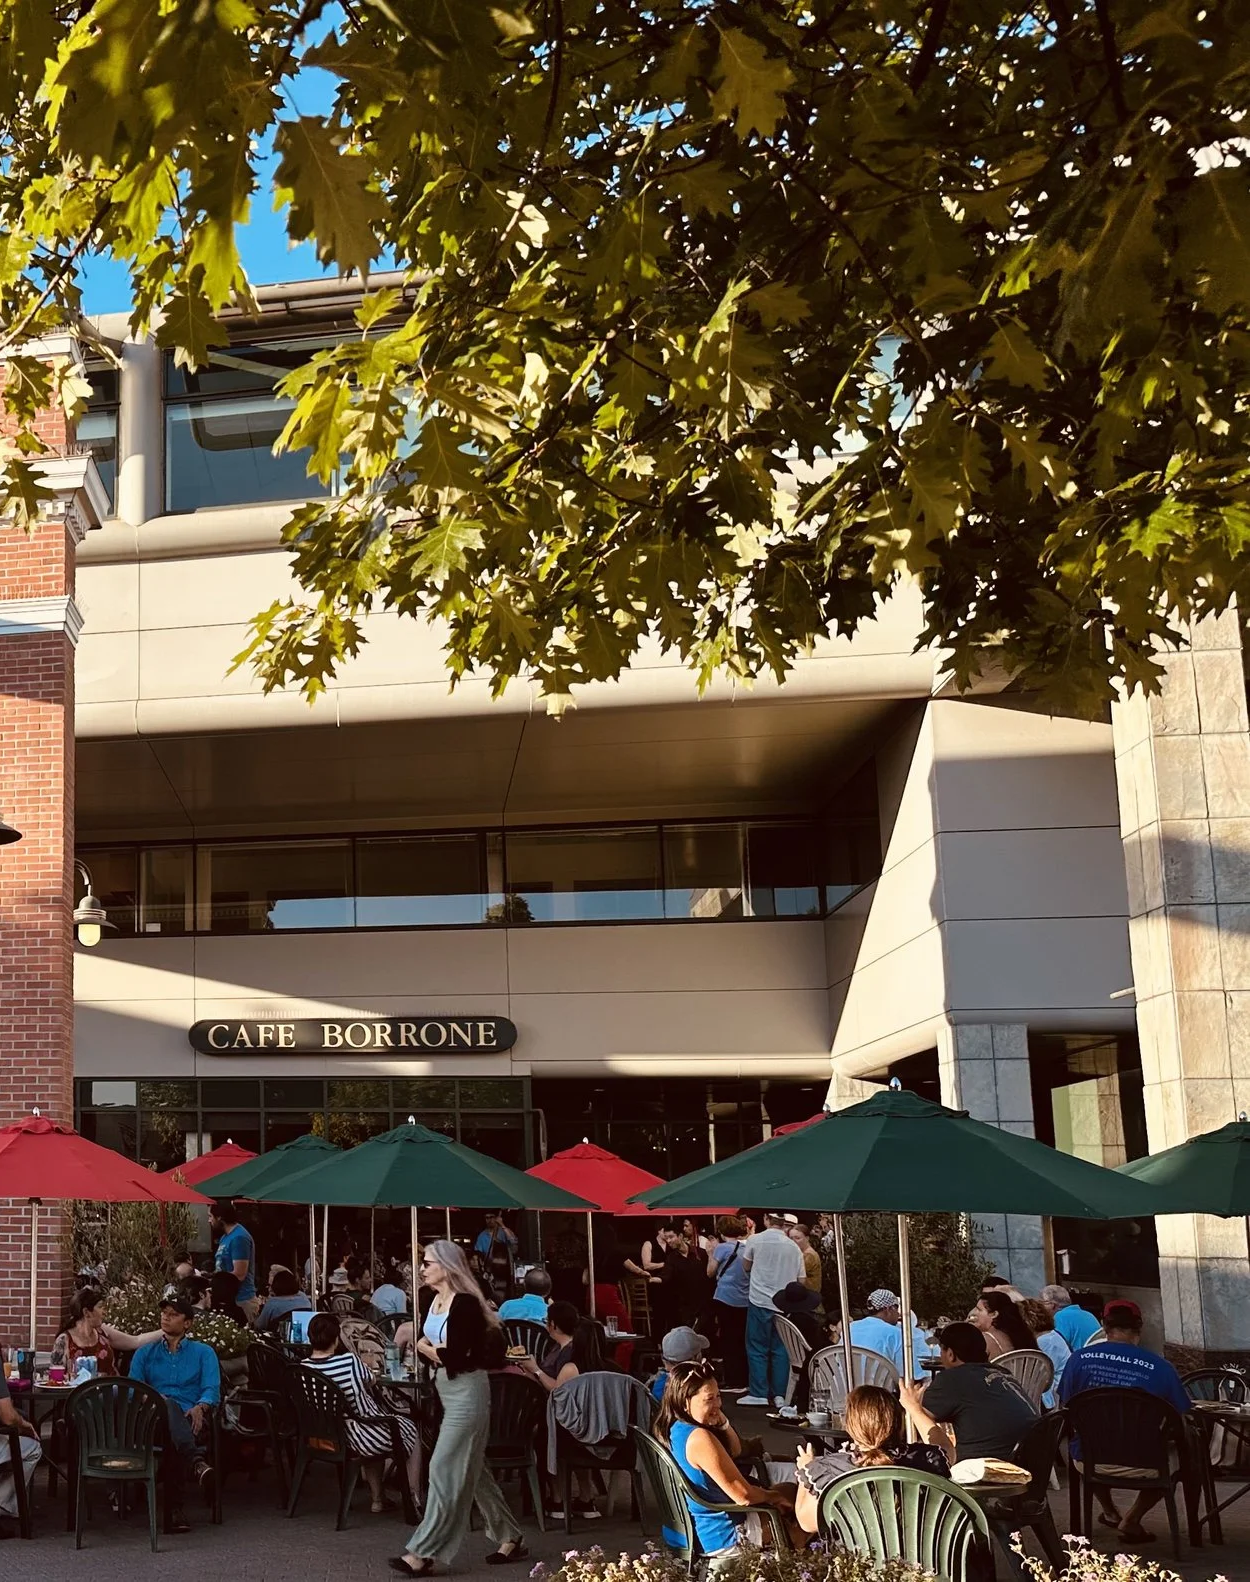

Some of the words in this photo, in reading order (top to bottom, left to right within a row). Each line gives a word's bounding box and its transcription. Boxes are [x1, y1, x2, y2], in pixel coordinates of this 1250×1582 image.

[208, 1023, 296, 1049] CAFE
[321, 1021, 497, 1048] BORRONE
[1080, 1352, 1132, 1363] VOLLEYBALL
[1133, 1358, 1155, 1370] 2023
